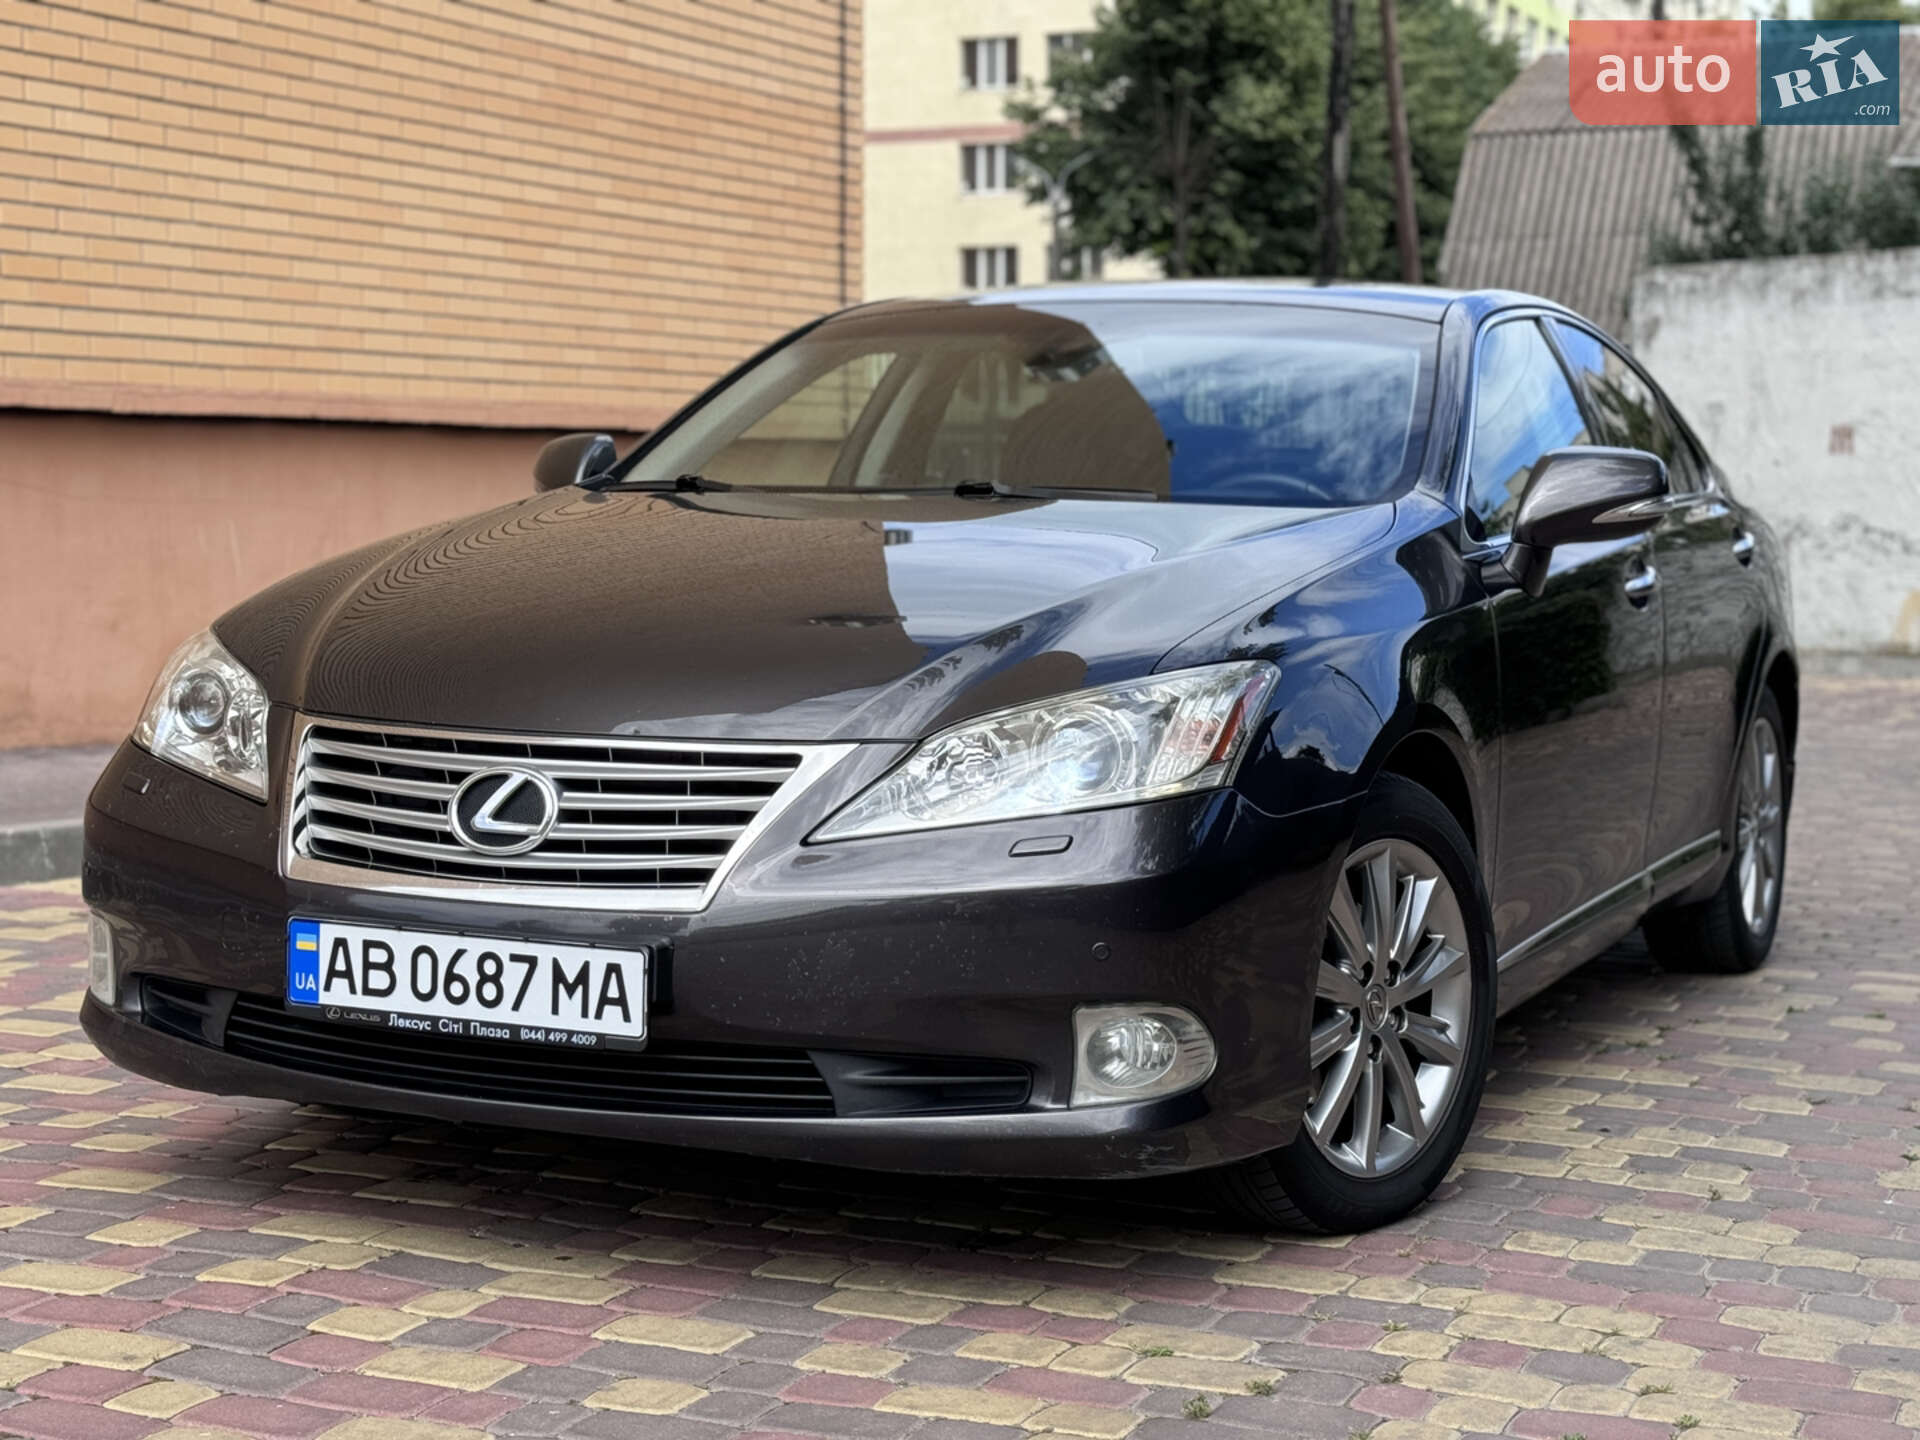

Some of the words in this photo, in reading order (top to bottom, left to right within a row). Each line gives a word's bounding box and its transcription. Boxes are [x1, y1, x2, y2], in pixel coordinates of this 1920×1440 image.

[295, 972, 317, 992] UA
[323, 937, 397, 998] AB
[410, 944, 539, 1013] 0687
[551, 957, 632, 1024] MA
[343, 1012, 382, 1022] LEXUS
[388, 1013, 432, 1031] Лексус
[438, 1018, 464, 1034] Сіті
[470, 1023, 510, 1039] Плаза
[520, 1028, 546, 1043] (044)
[548, 1032, 568, 1043] 499
[571, 1034, 597, 1047] 4009
